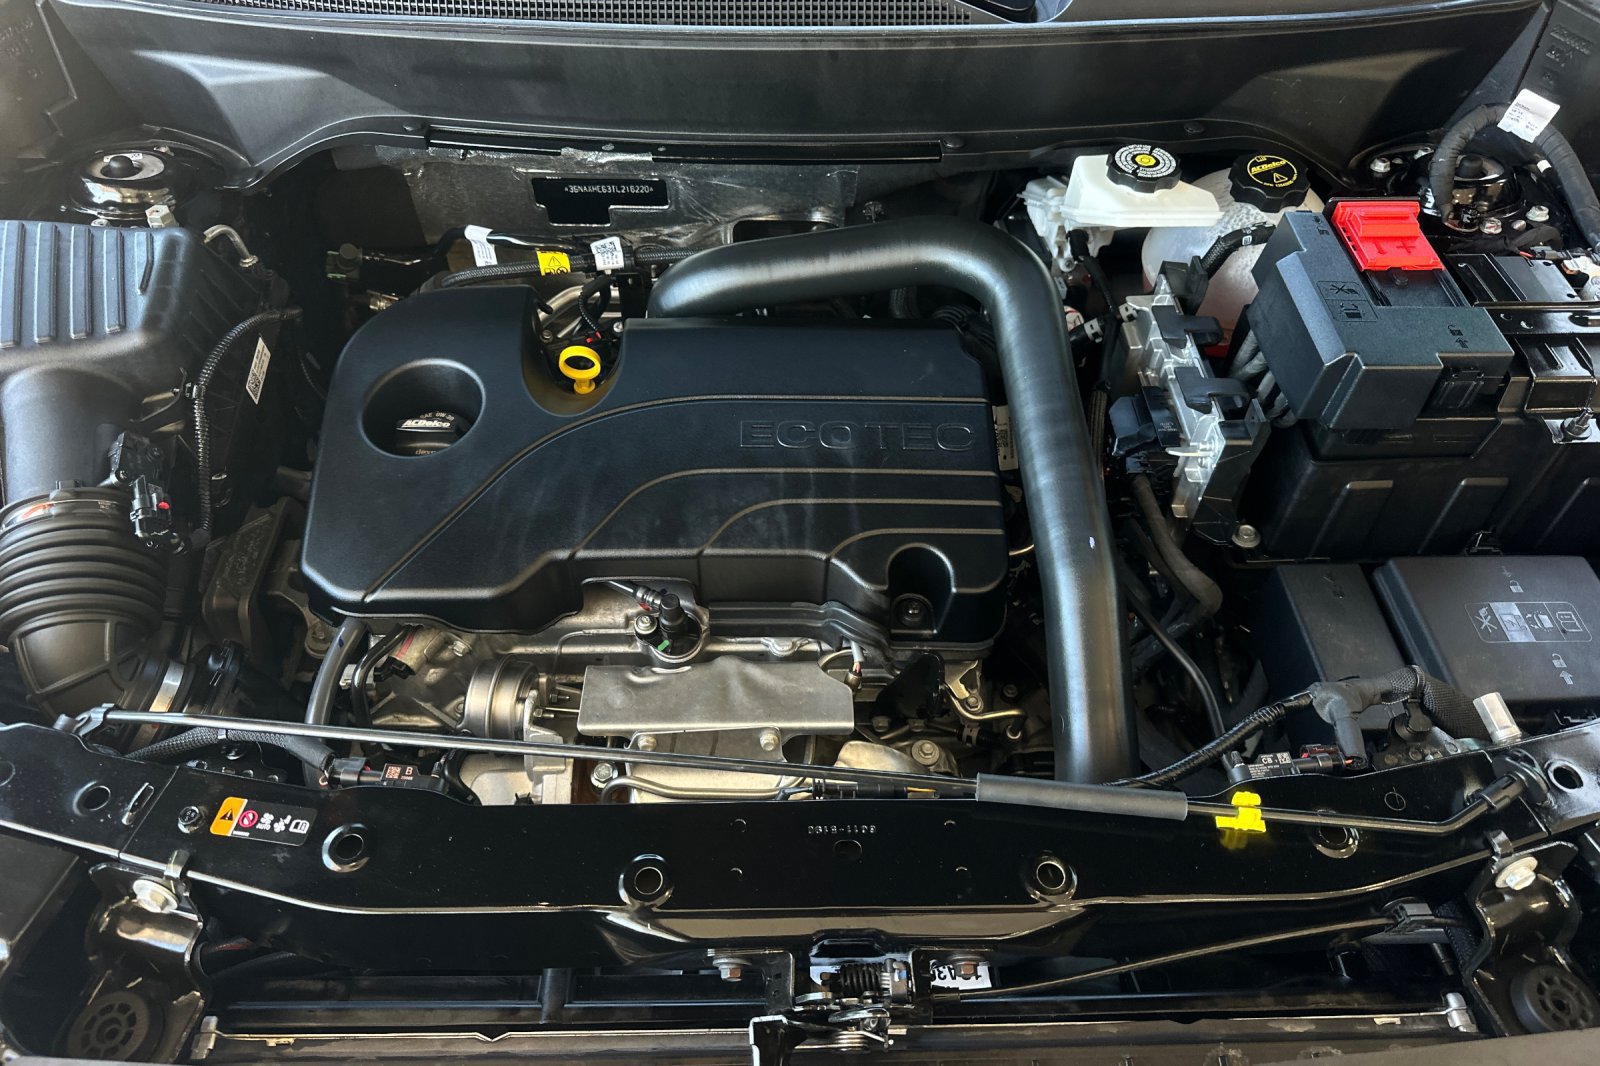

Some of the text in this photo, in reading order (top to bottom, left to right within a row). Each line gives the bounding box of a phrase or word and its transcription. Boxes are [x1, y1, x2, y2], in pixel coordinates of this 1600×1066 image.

[1251, 160, 1287, 175] ACDelco
[401, 419, 451, 428] ACDelco
[739, 419, 976, 451] ECOTEC
[405, 766, 413, 775] B
